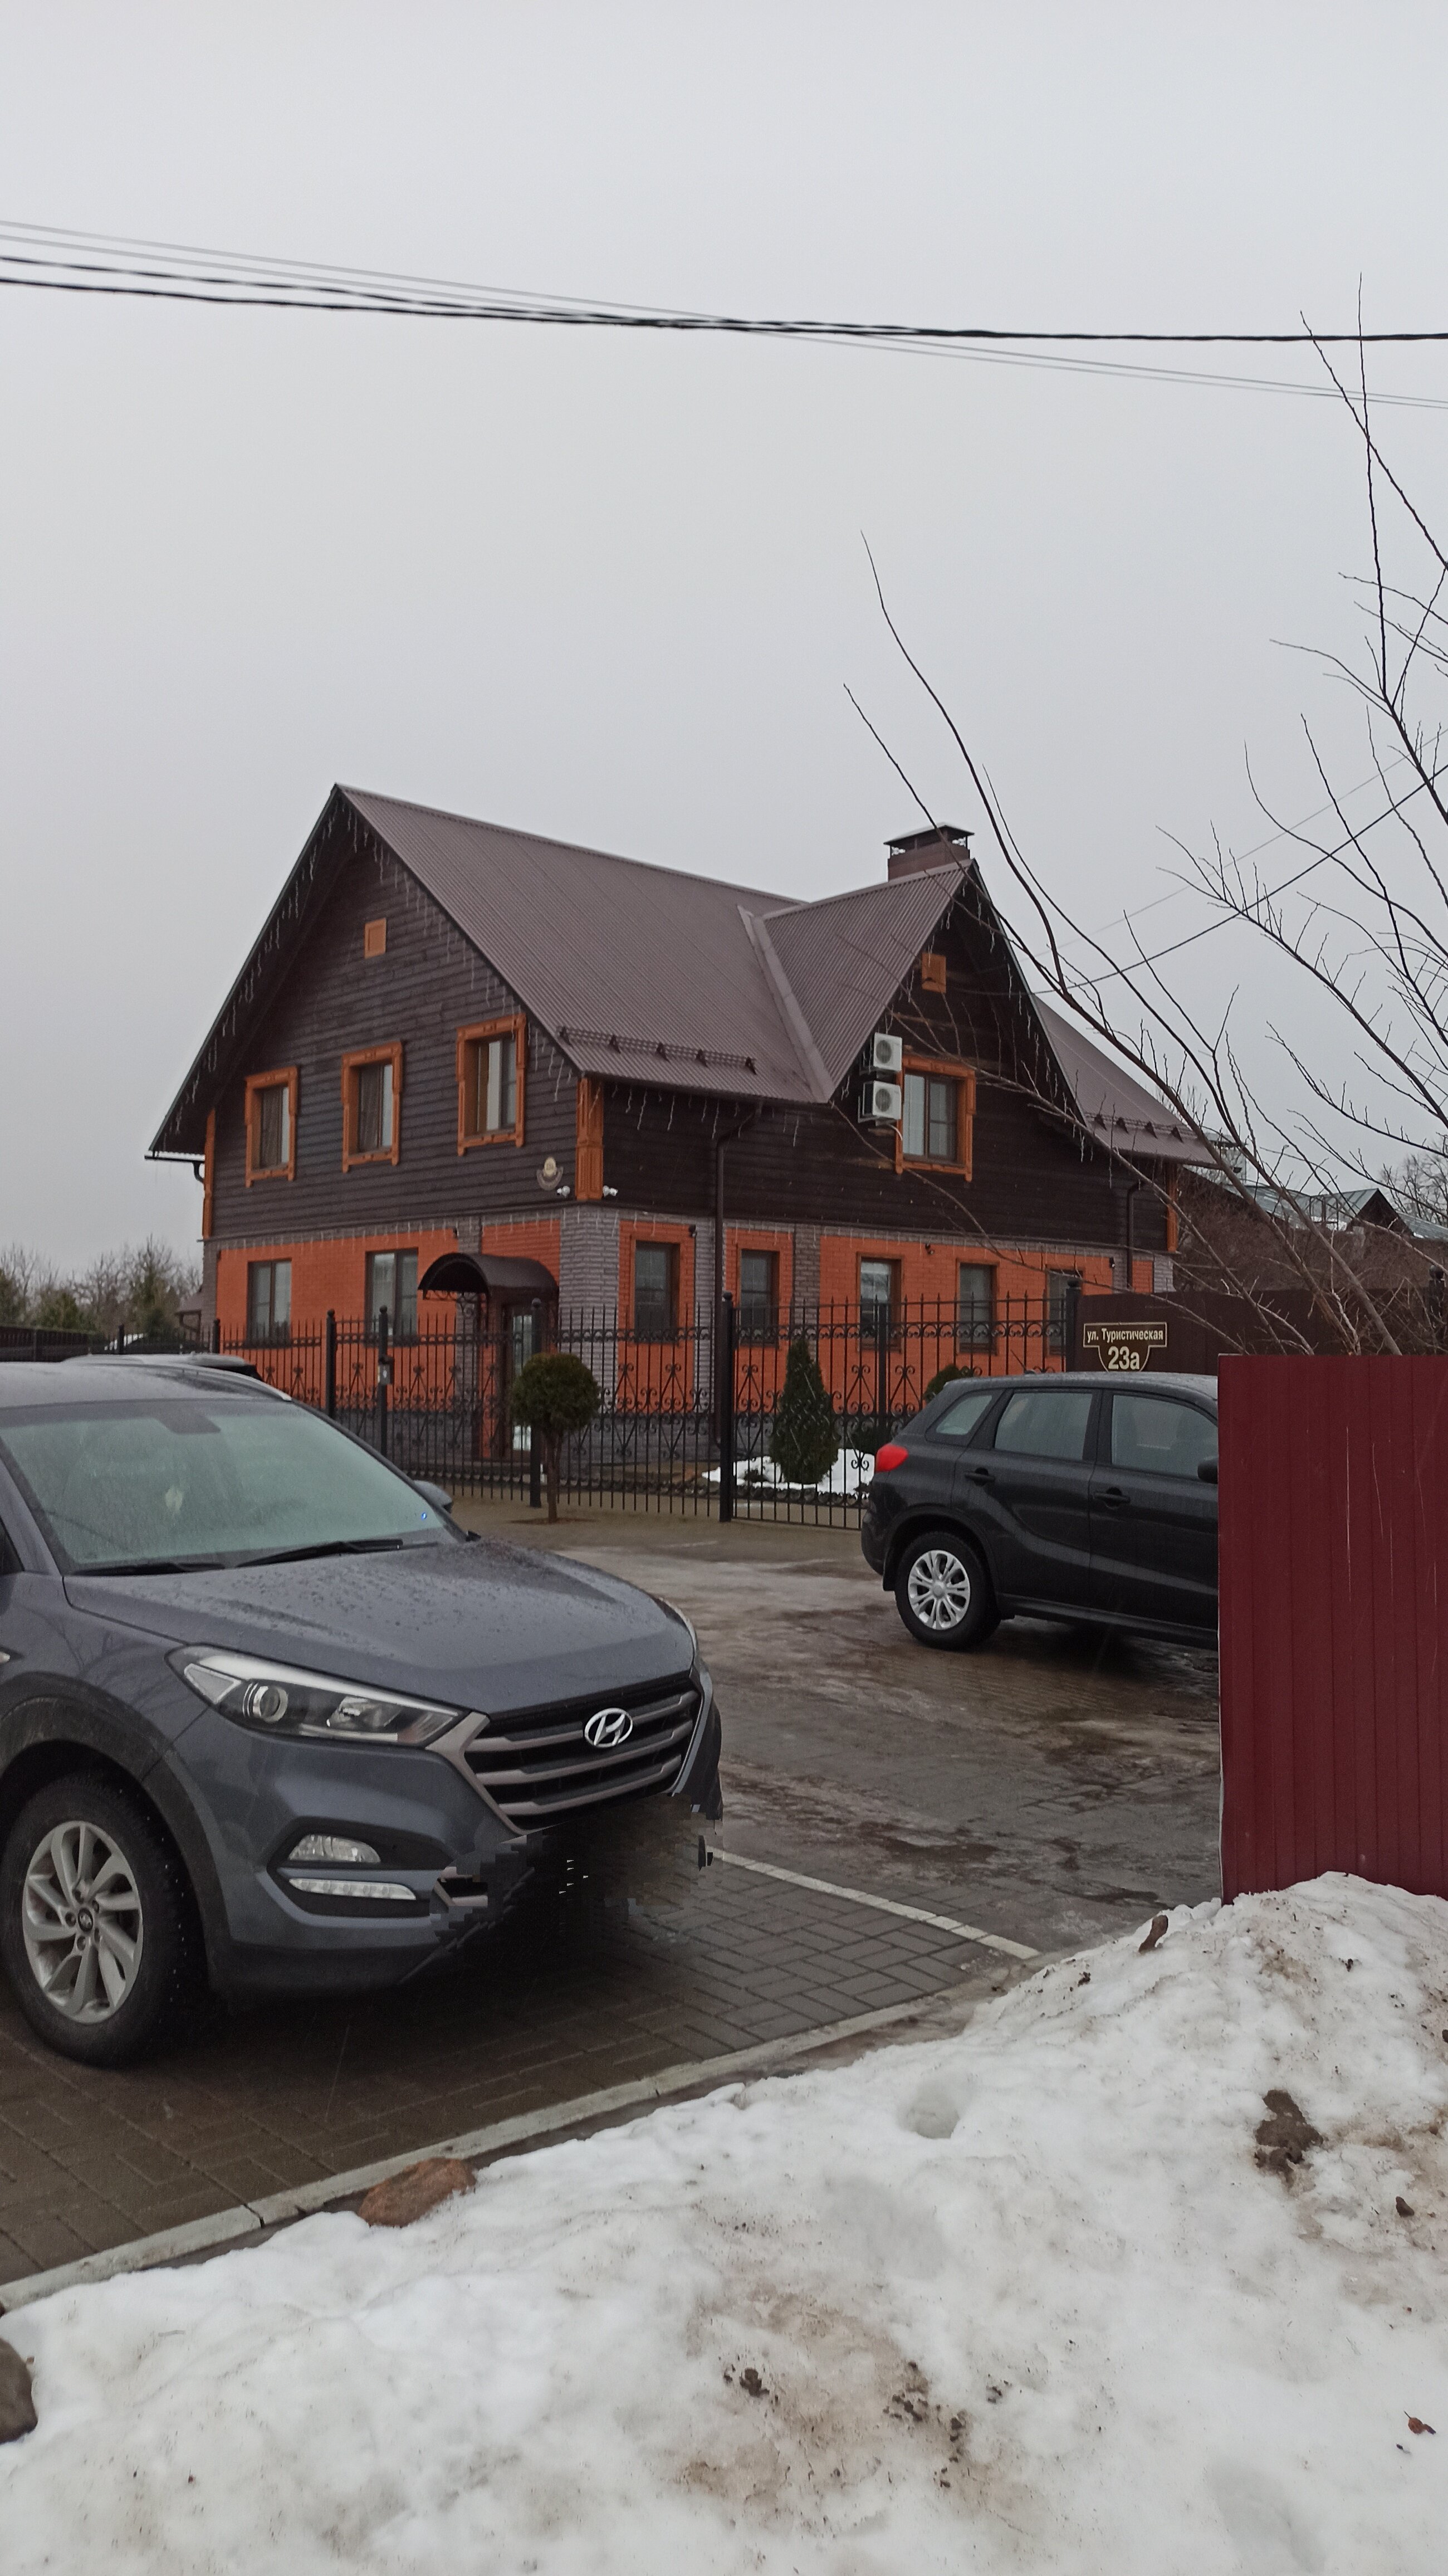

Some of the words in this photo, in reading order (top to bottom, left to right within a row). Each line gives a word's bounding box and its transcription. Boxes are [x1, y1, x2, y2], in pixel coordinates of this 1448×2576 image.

[1087, 1330, 1099, 1343] ул.
[1101, 1328, 1163, 1343] Туристическая
[1108, 1346, 1140, 1370] 23а
